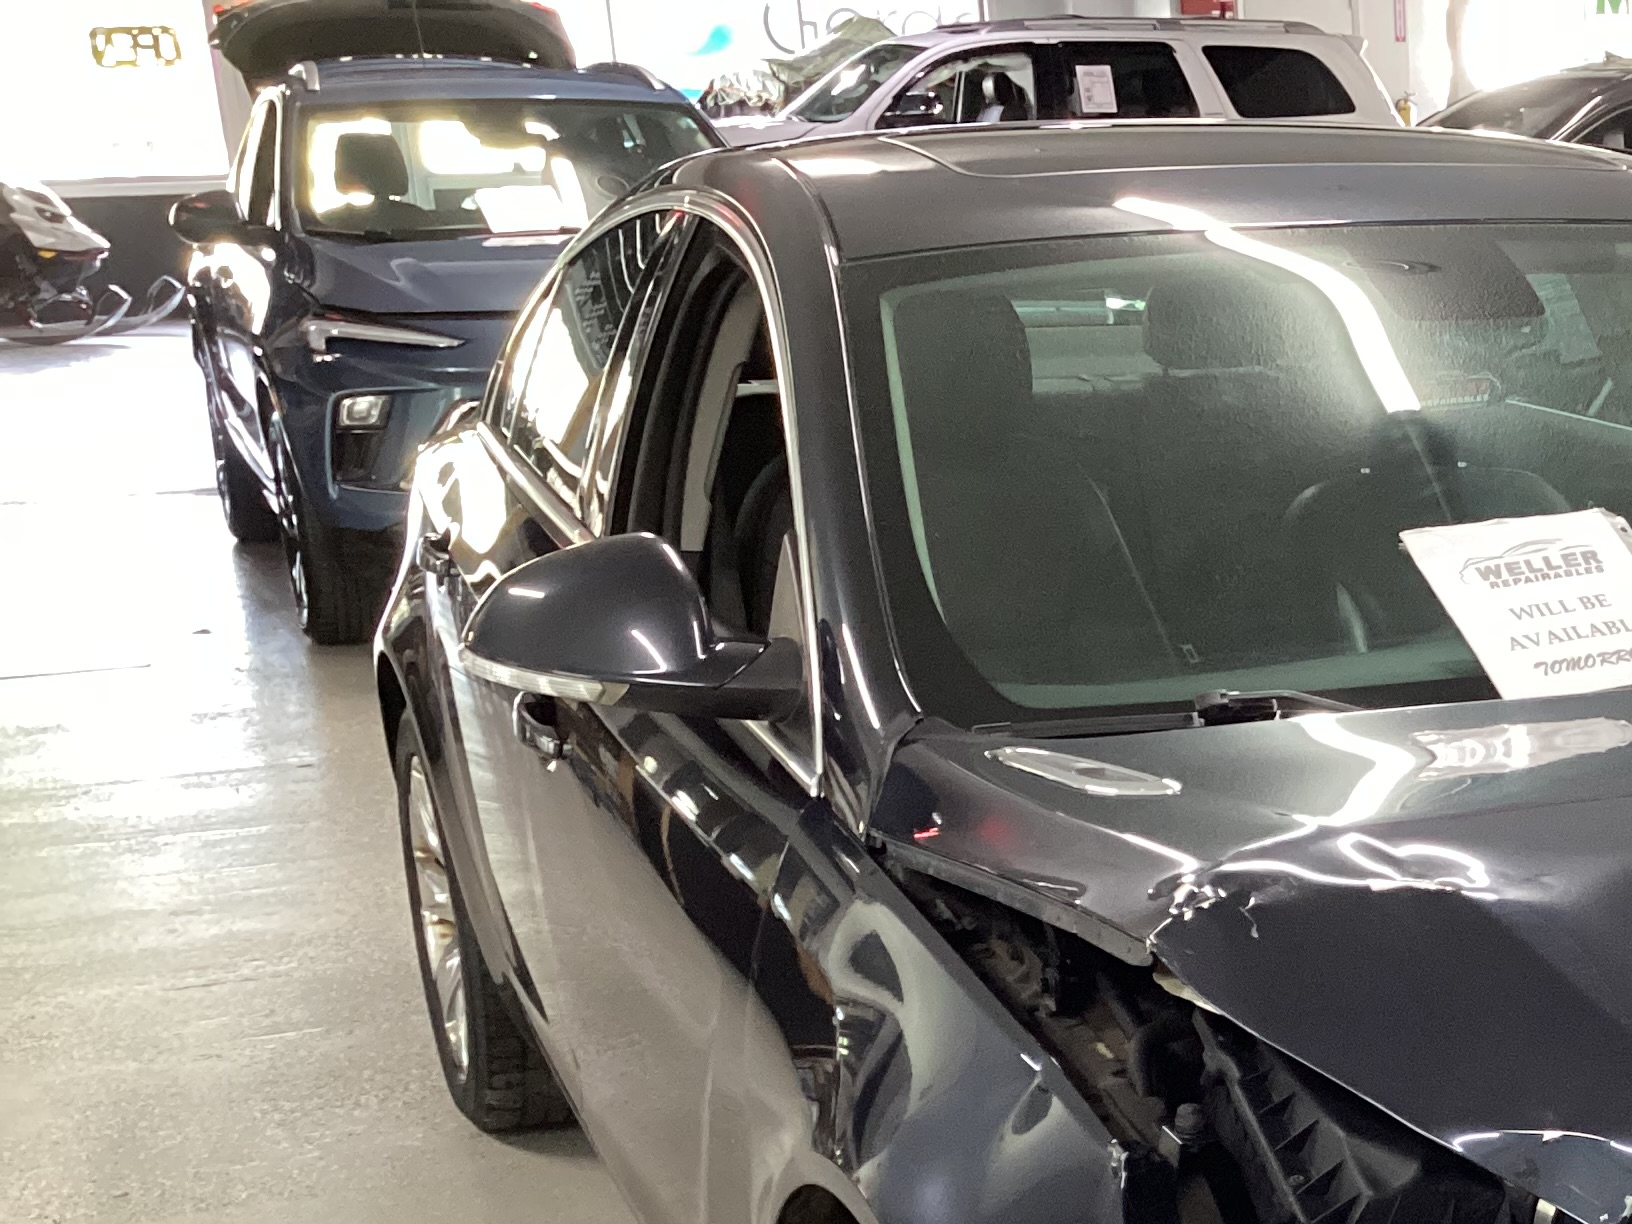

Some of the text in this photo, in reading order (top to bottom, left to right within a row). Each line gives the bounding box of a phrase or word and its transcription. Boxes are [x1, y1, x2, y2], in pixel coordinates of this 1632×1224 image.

[1475, 550, 1603, 582] WELLER
[1489, 565, 1605, 589] REPAIRABLES
[1508, 593, 1612, 621] WILL BE
